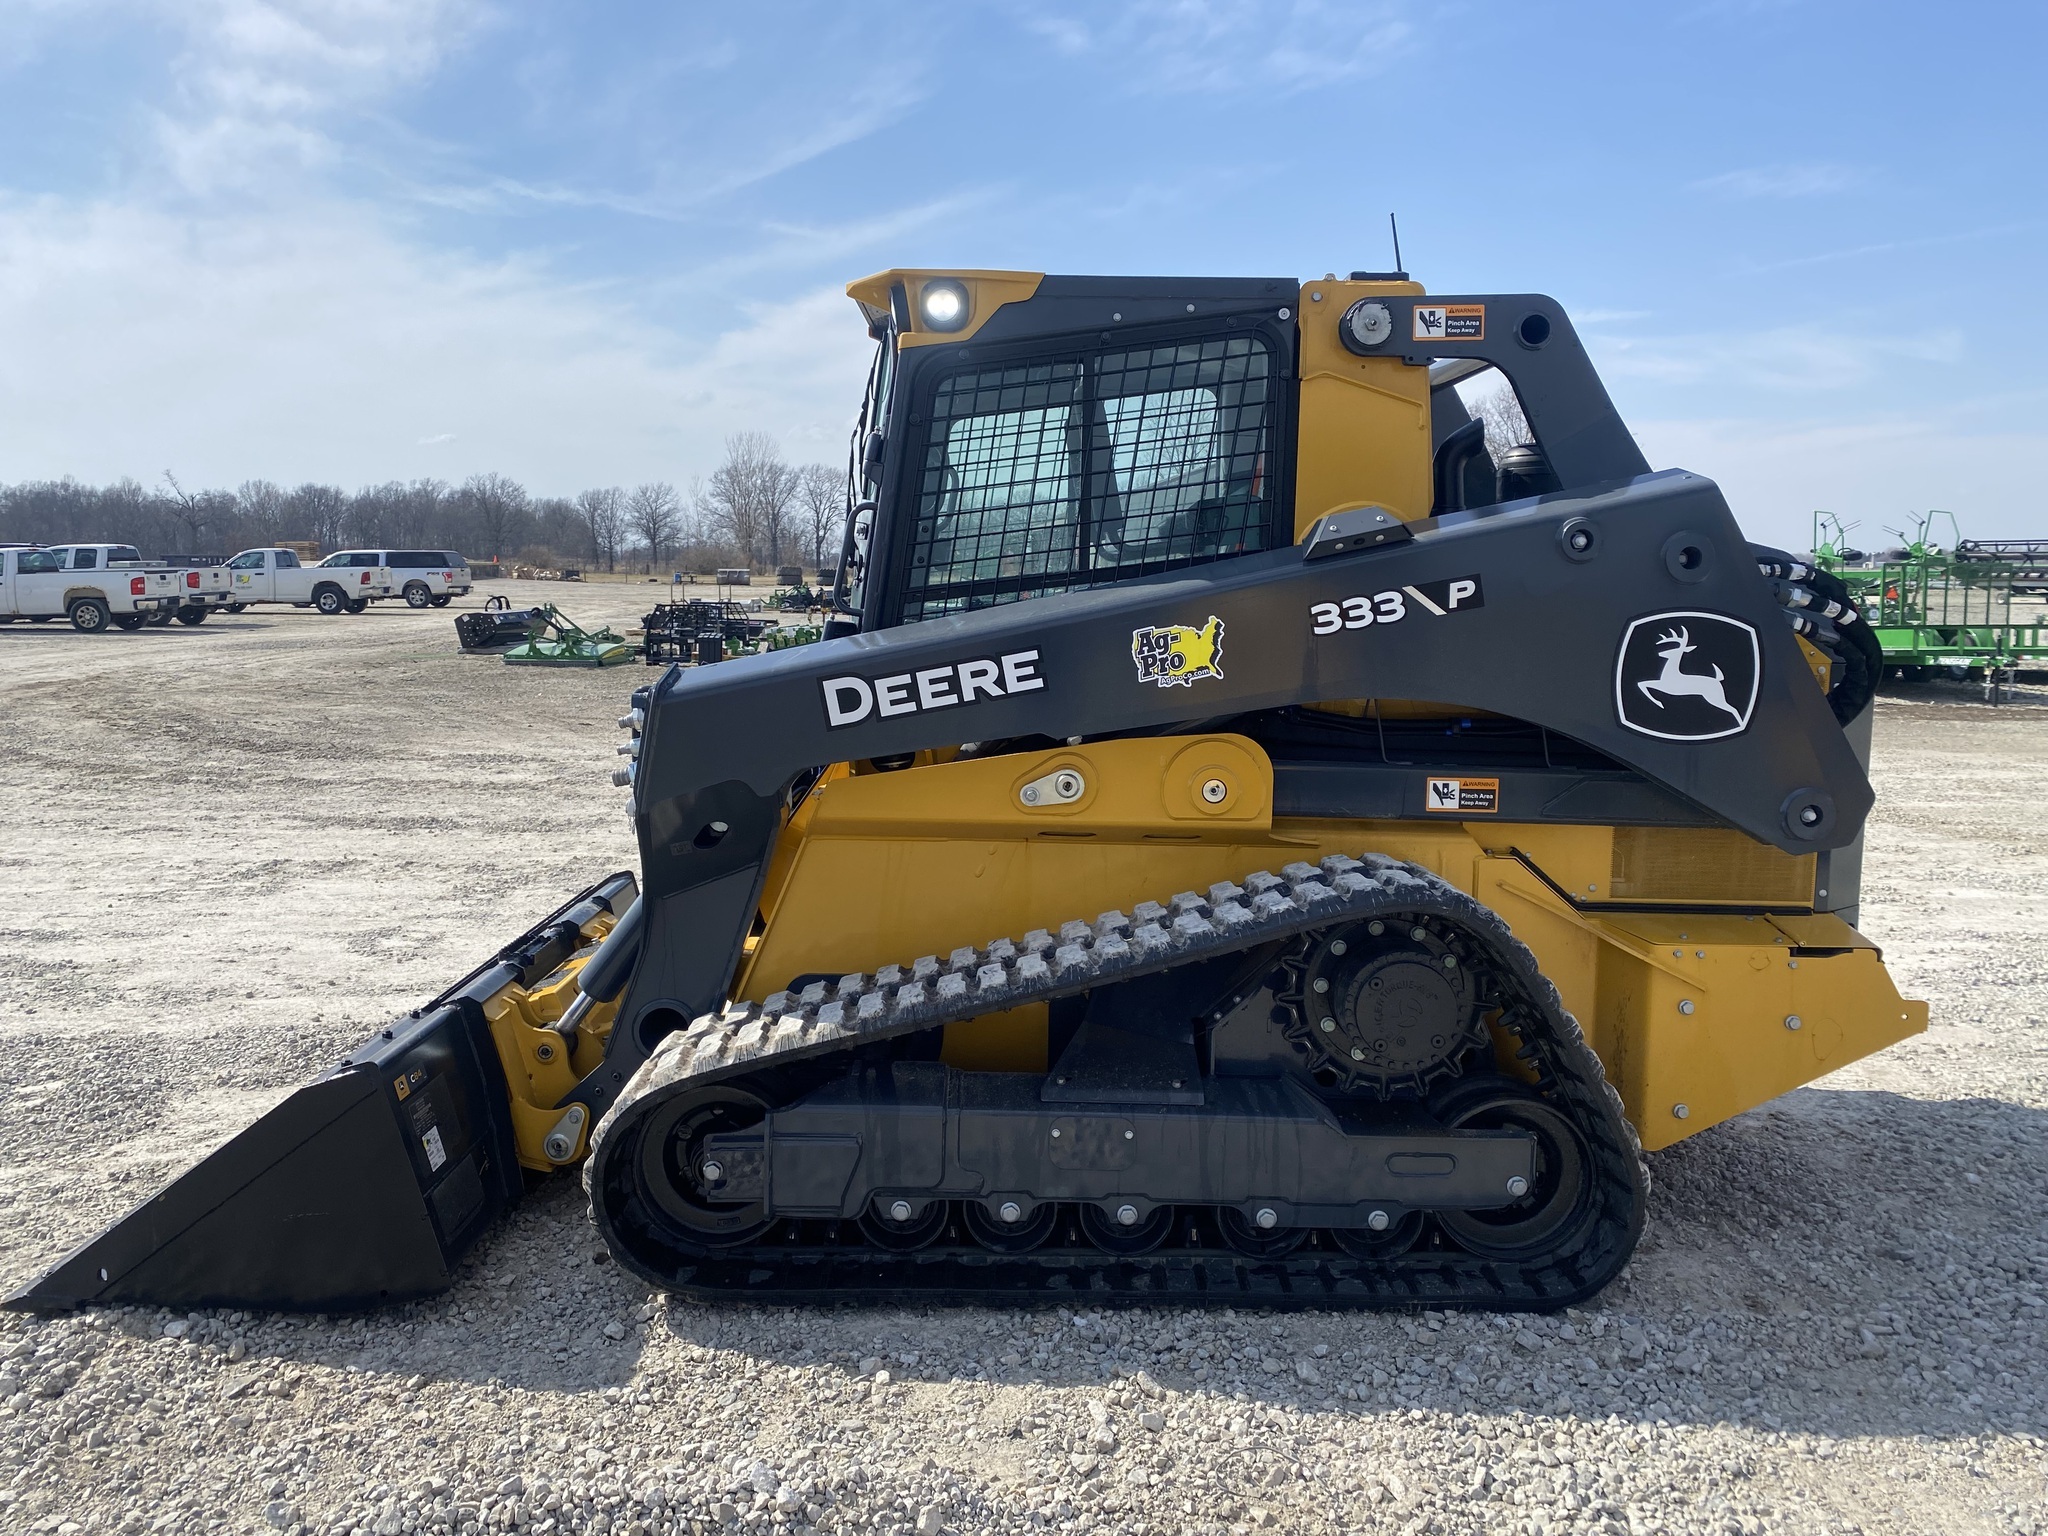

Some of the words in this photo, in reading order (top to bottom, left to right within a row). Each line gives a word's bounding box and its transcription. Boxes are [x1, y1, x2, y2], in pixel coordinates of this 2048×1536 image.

[1138, 631, 1180, 655] Ag-
[1140, 652, 1185, 678] Pro
[1161, 668, 1210, 684] AgProCo.com
[822, 649, 1044, 727] DEERE
[410, 1068, 422, 1083] C84
